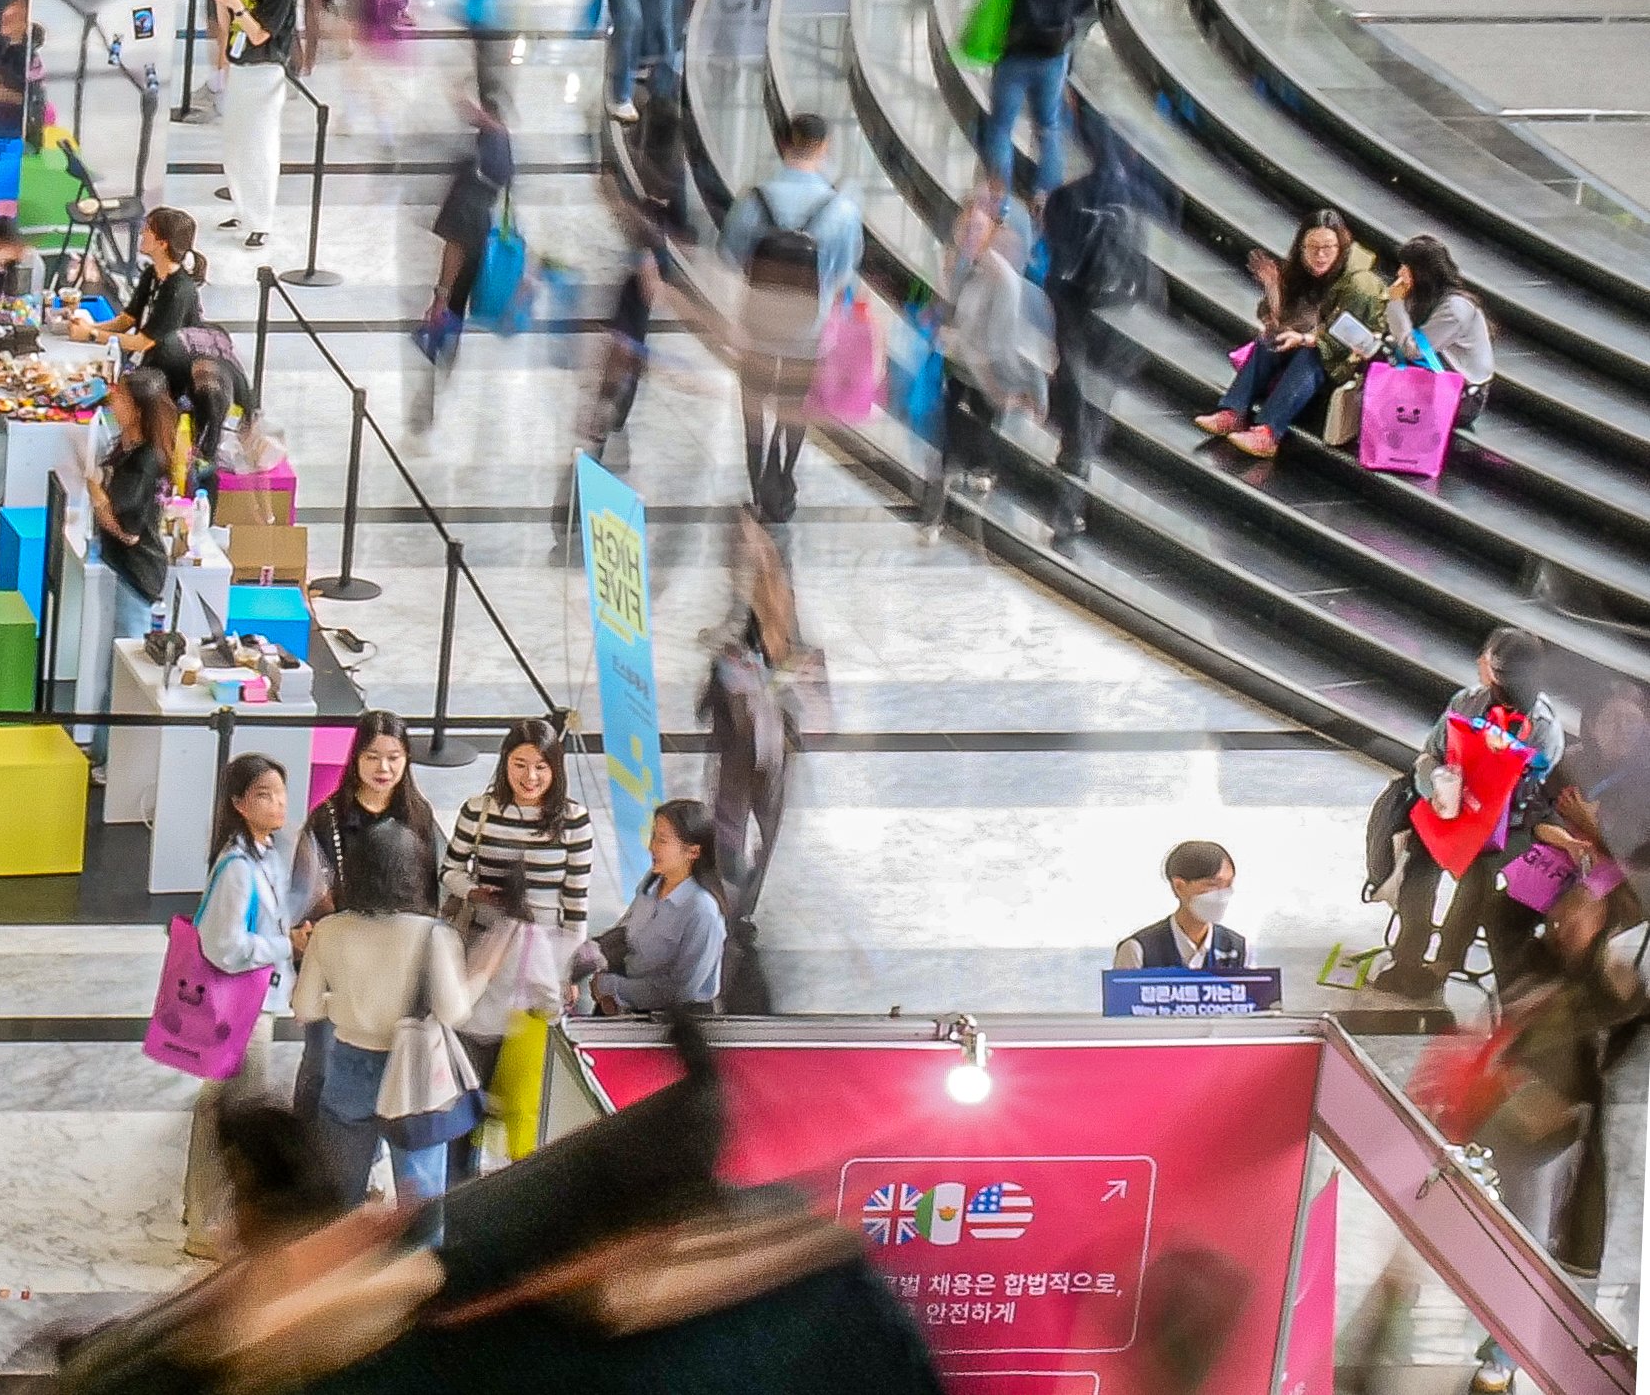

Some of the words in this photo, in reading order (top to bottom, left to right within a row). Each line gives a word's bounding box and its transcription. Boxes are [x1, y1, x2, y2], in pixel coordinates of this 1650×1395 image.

[1202, 984, 1247, 1003] 가는길
[1173, 1003, 1197, 1016] JOB
[1198, 1002, 1257, 1015] CONCERT
[928, 1273, 996, 1297] 채용은
[1003, 1272, 1123, 1298] 합법적으로,
[926, 1302, 1017, 1325] 안전하게
